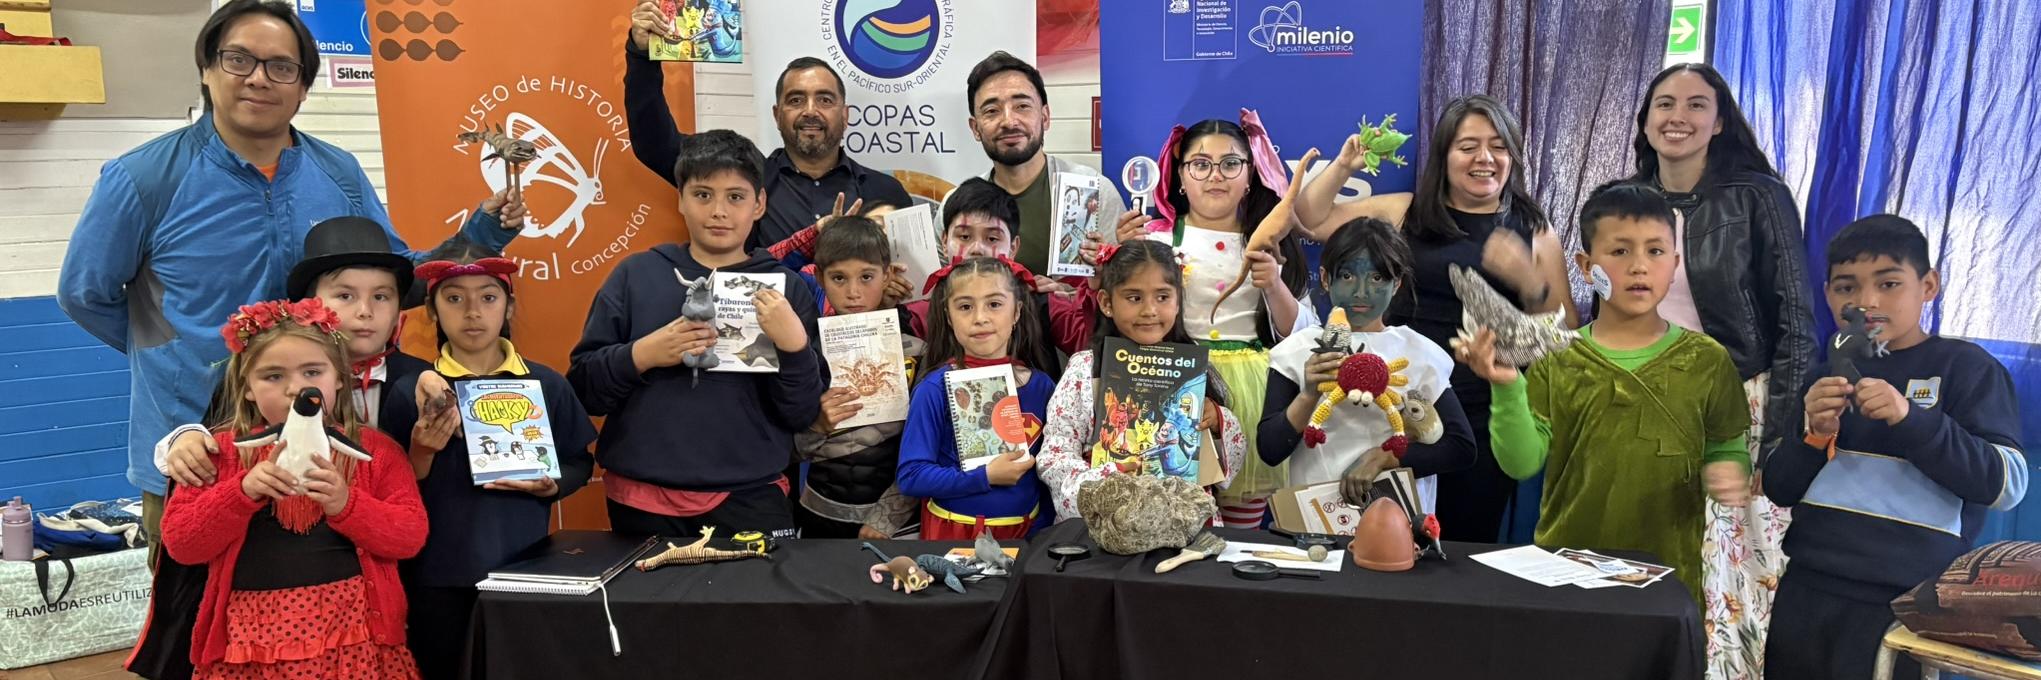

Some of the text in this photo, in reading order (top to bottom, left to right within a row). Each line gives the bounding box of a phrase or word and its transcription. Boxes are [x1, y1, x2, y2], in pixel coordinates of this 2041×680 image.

[940, 0, 954, 38] RÁFICA
[316, 40, 354, 52] lencio
[1276, 26, 1354, 45] milenio
[337, 67, 375, 80] Silenc
[827, 43, 950, 94] EN EL PACÍFICO SUR-ORIENTAL
[516, 75, 541, 93] de
[550, 75, 632, 152] HISTORIA
[847, 105, 935, 126] COPAS
[846, 131, 956, 153] OASTAL
[720, 298, 754, 306] Tiburon
[1115, 349, 1172, 366] Cuentos
[1174, 357, 1196, 368] del
[1127, 362, 1181, 378] Océano
[477, 400, 530, 421] HACKY
[6, 588, 152, 618] #LAMODAESREUTILIZ
